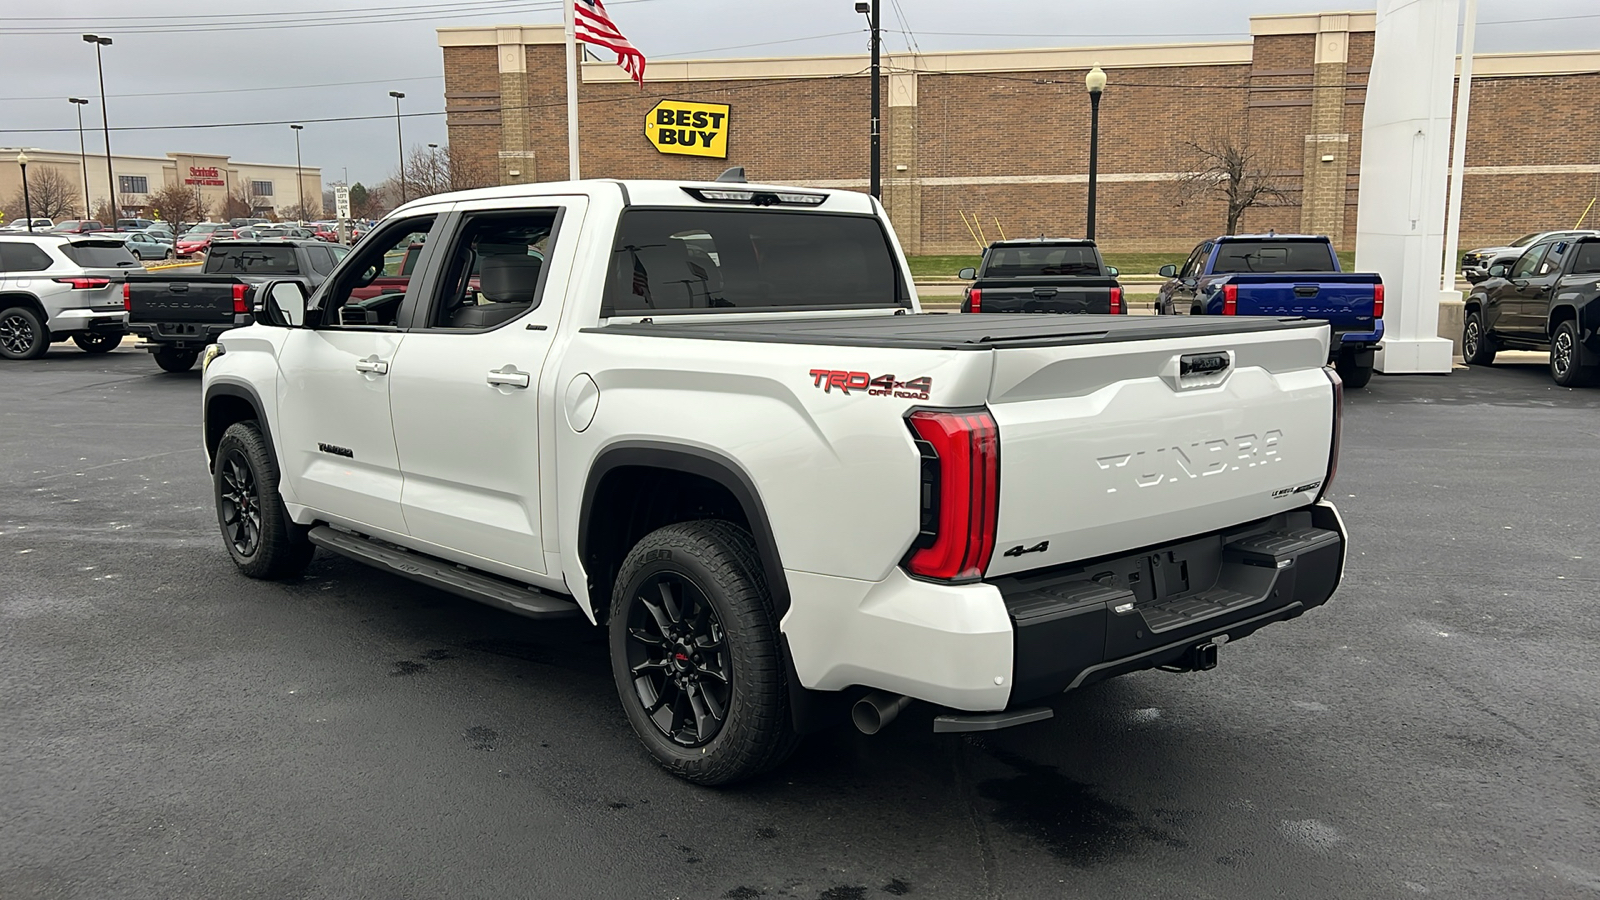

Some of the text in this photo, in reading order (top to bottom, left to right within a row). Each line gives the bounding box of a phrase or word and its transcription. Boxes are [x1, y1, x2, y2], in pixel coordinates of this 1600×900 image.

[657, 108, 725, 129] BEST
[659, 128, 718, 148] BUY
[1259, 305, 1353, 313] TACOMA
[809, 369, 932, 396] TRD 4x4
[868, 388, 930, 401] OFF ROAD
[1096, 428, 1284, 494] TUNDRA
